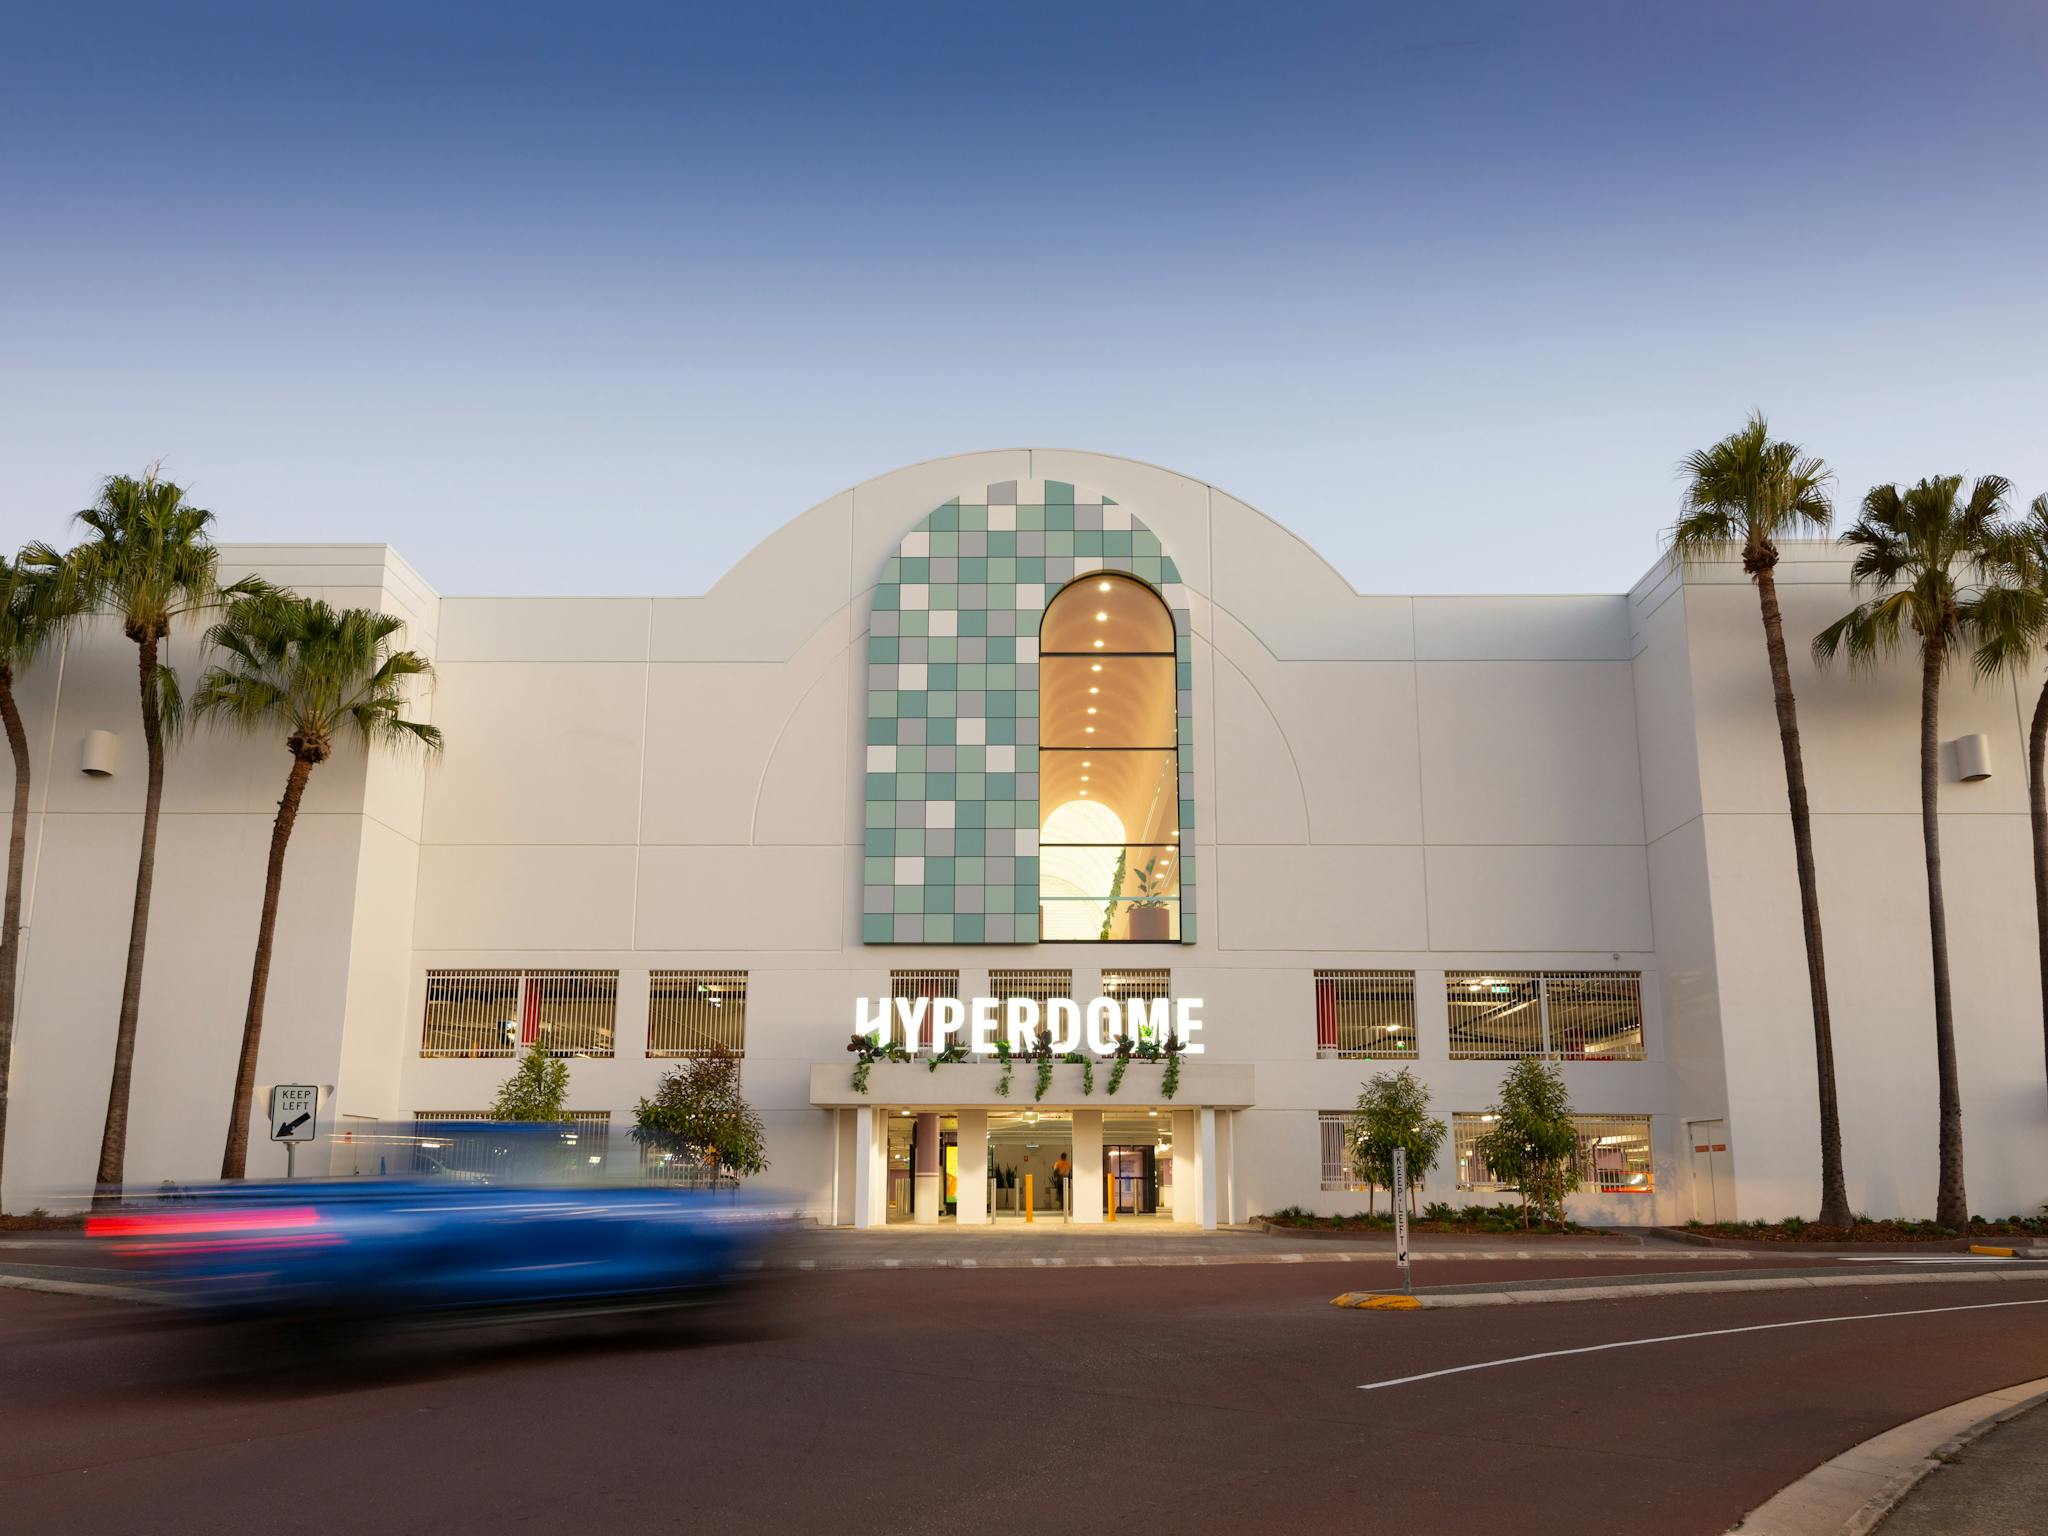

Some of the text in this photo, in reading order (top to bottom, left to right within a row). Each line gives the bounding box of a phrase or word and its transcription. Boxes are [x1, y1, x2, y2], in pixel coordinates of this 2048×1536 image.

[855, 996, 1205, 1054] HYPERDOME
[282, 1090, 311, 1099] KEEP
[282, 1101, 309, 1110] LEFT
